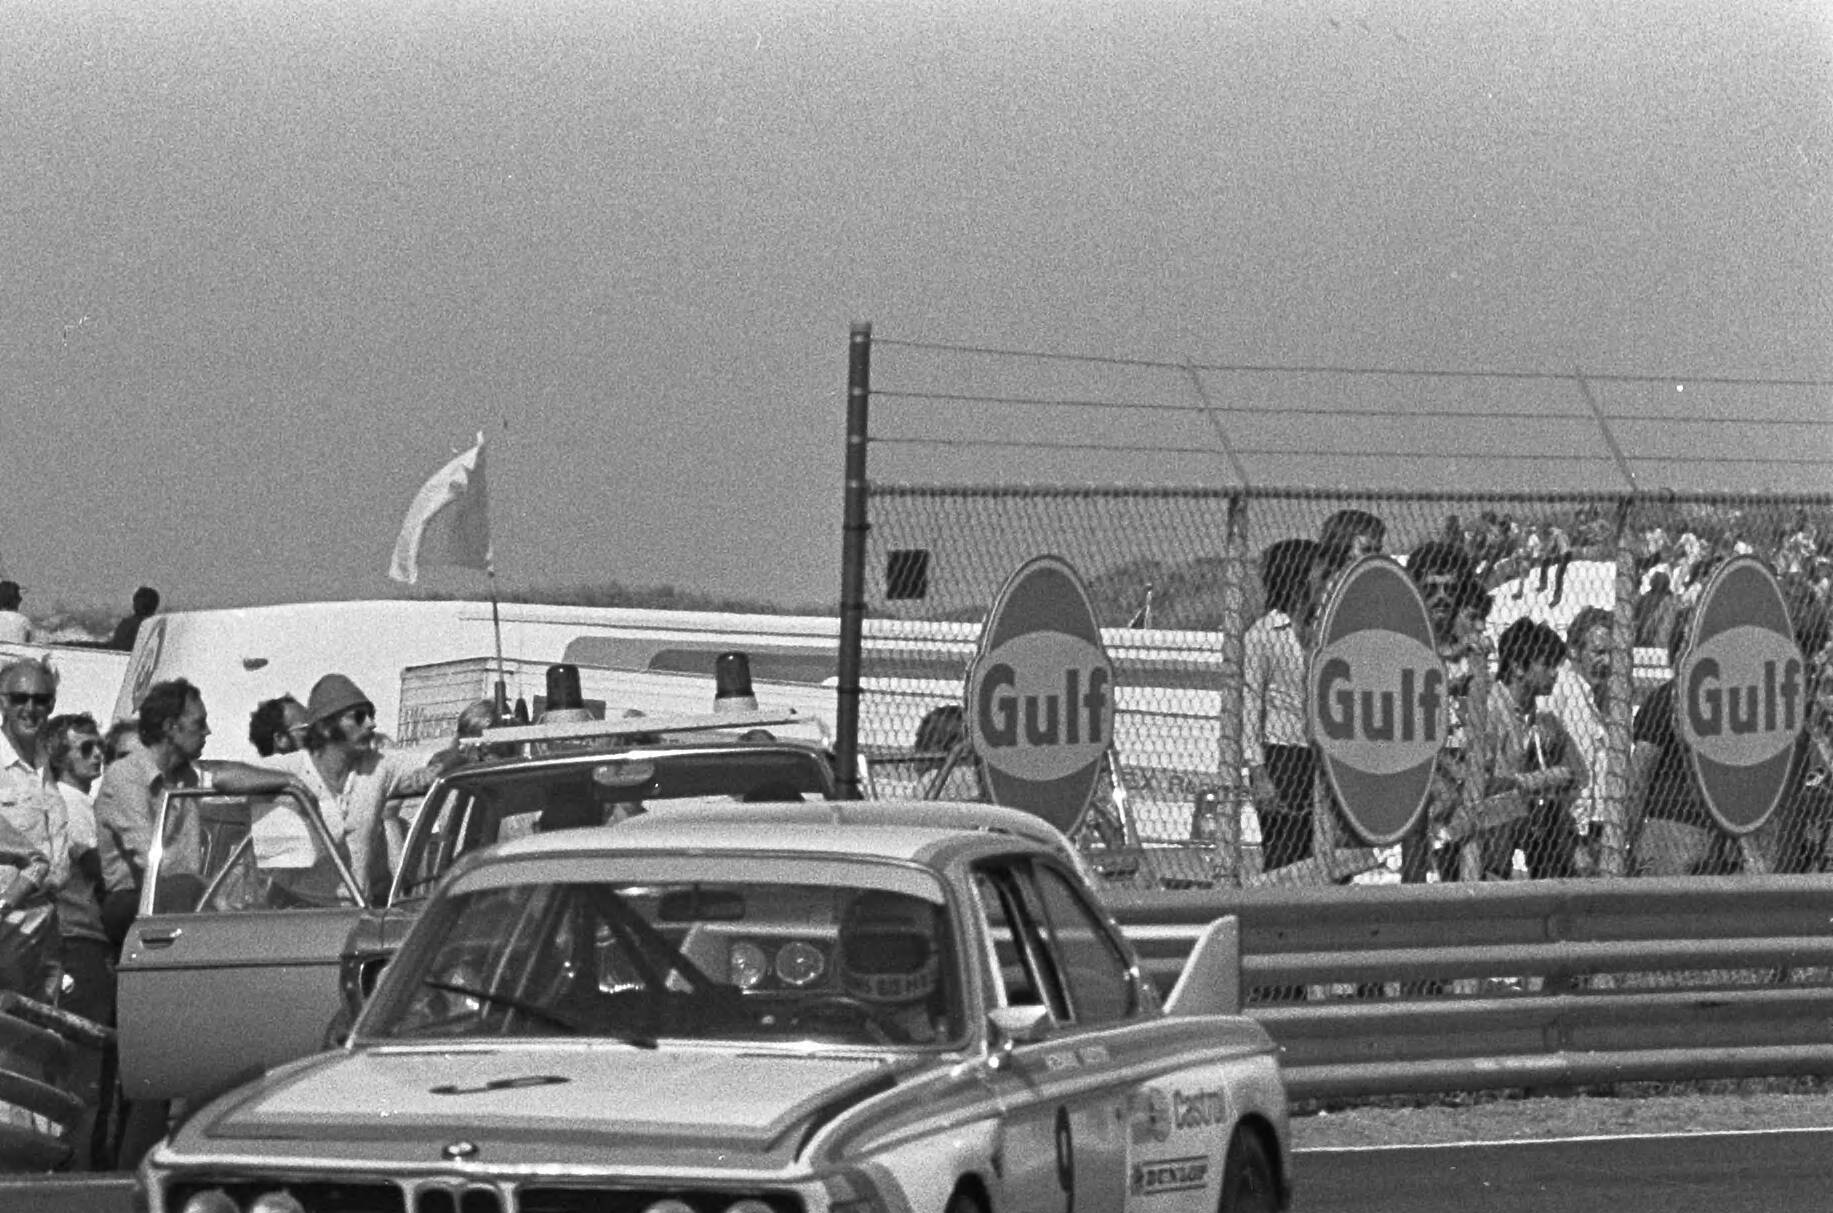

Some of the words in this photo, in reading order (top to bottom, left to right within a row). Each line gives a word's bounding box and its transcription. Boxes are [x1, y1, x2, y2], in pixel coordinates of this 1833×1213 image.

[978, 663, 1111, 748] Gulf
[1317, 658, 1445, 741] Gulf
[1687, 657, 1803, 737] Gulf
